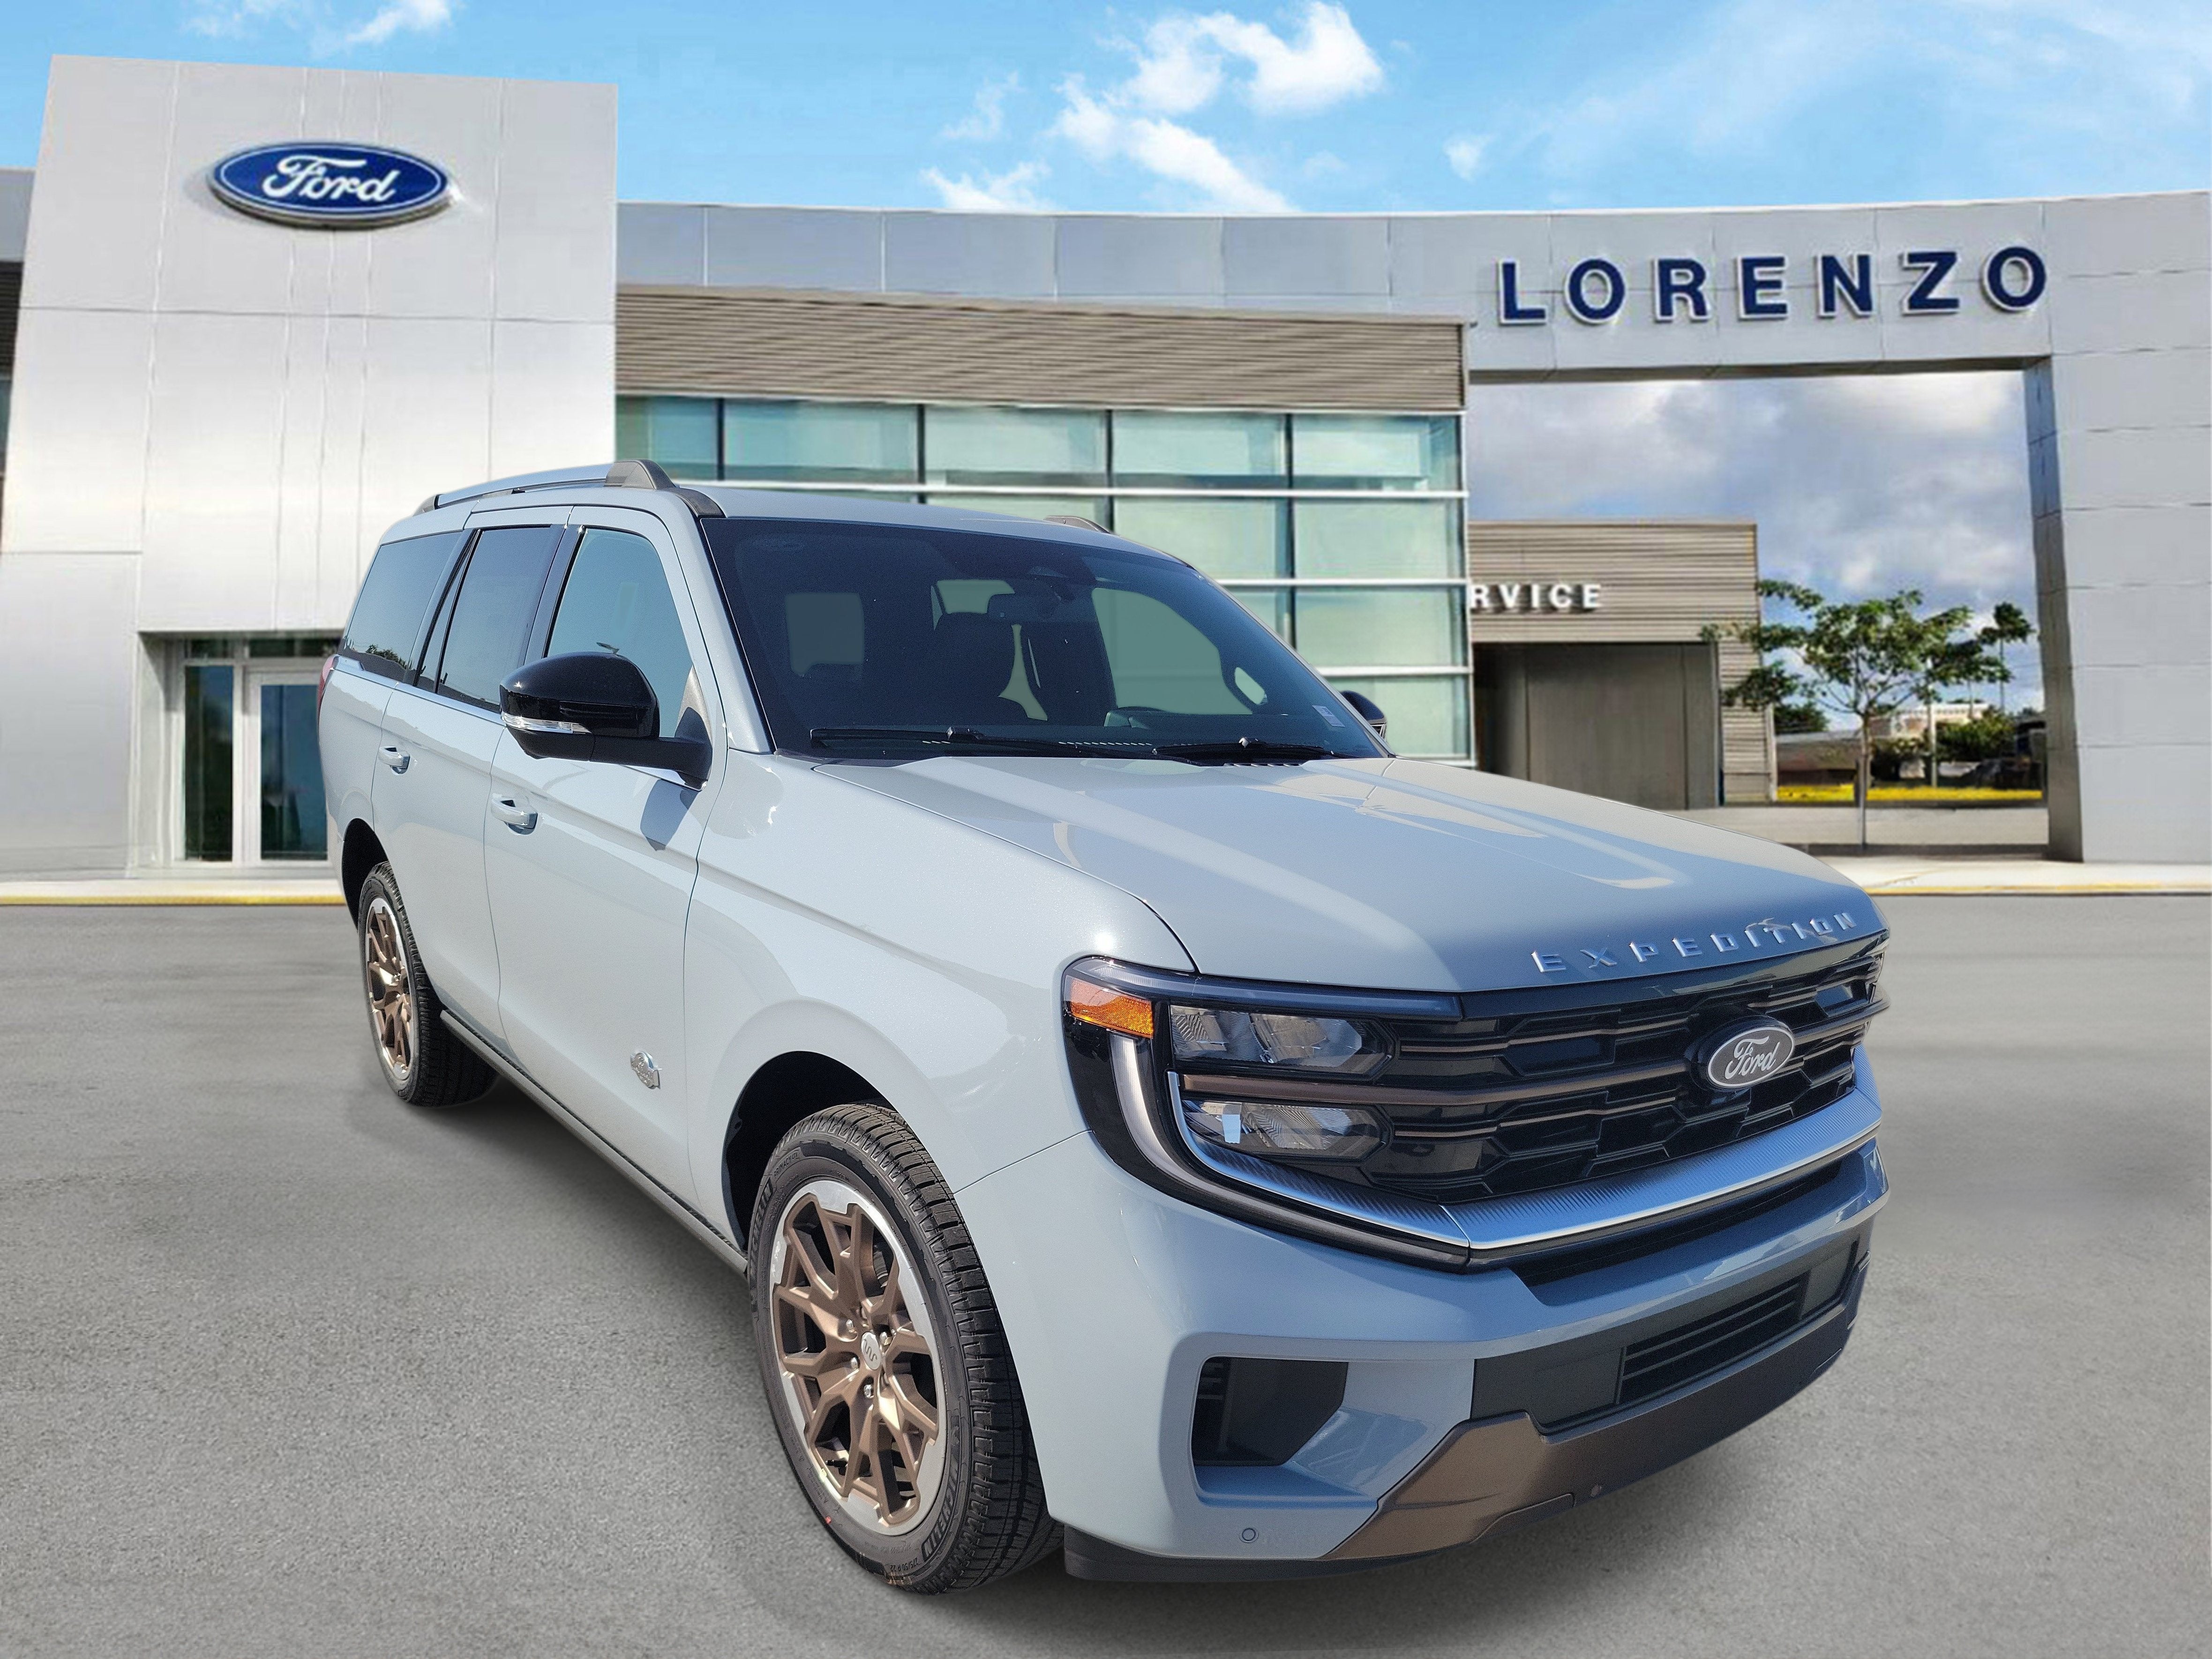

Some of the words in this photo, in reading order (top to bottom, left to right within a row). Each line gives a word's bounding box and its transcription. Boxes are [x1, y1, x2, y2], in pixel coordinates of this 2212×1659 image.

[262, 154, 400, 202] Ford
[1498, 246, 2047, 324] LORENZO
[1530, 912, 1856, 973] EXPEDITION
[1725, 1036, 1781, 1080] Ford
